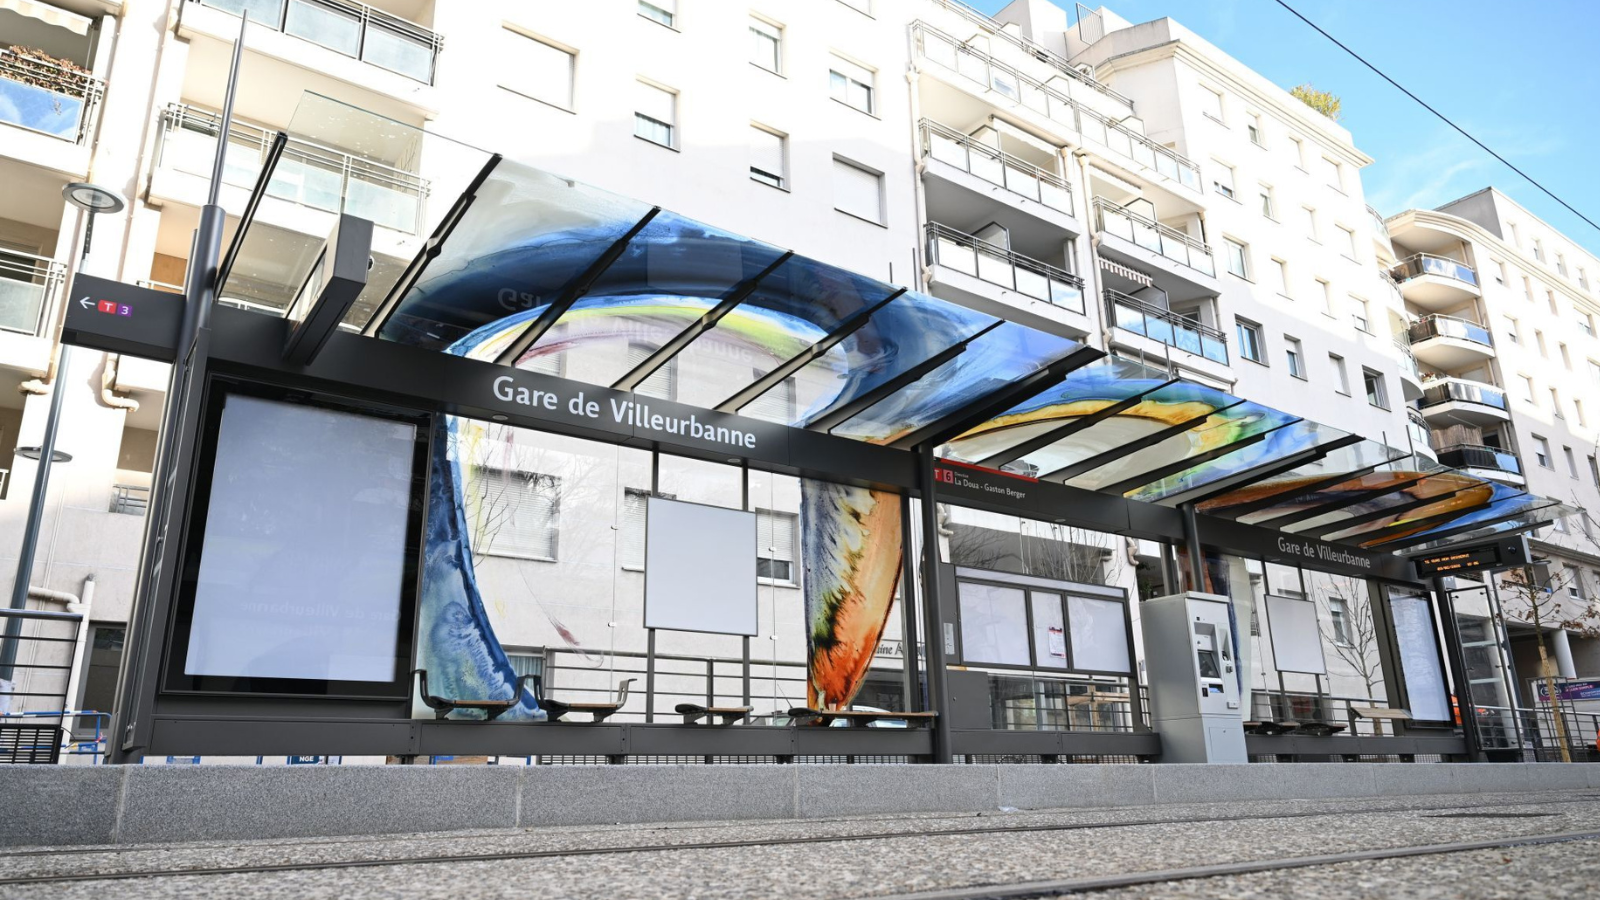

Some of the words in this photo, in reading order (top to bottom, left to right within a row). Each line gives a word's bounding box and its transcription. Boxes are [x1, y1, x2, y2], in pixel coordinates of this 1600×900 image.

[104, 302, 113, 312] T
[121, 305, 129, 315] 3
[492, 375, 558, 410] Gare
[568, 391, 600, 418] de
[610, 397, 756, 449] Villeurbanne
[945, 471, 951, 482] 6
[954, 477, 962, 486] La
[963, 479, 980, 489] Doua
[984, 483, 1005, 494] Gaston
[1006, 487, 1026, 499] Berger
[1277, 536, 1301, 555] Gare
[1303, 542, 1315, 558] de
[1316, 544, 1371, 568] Villeurbanne
